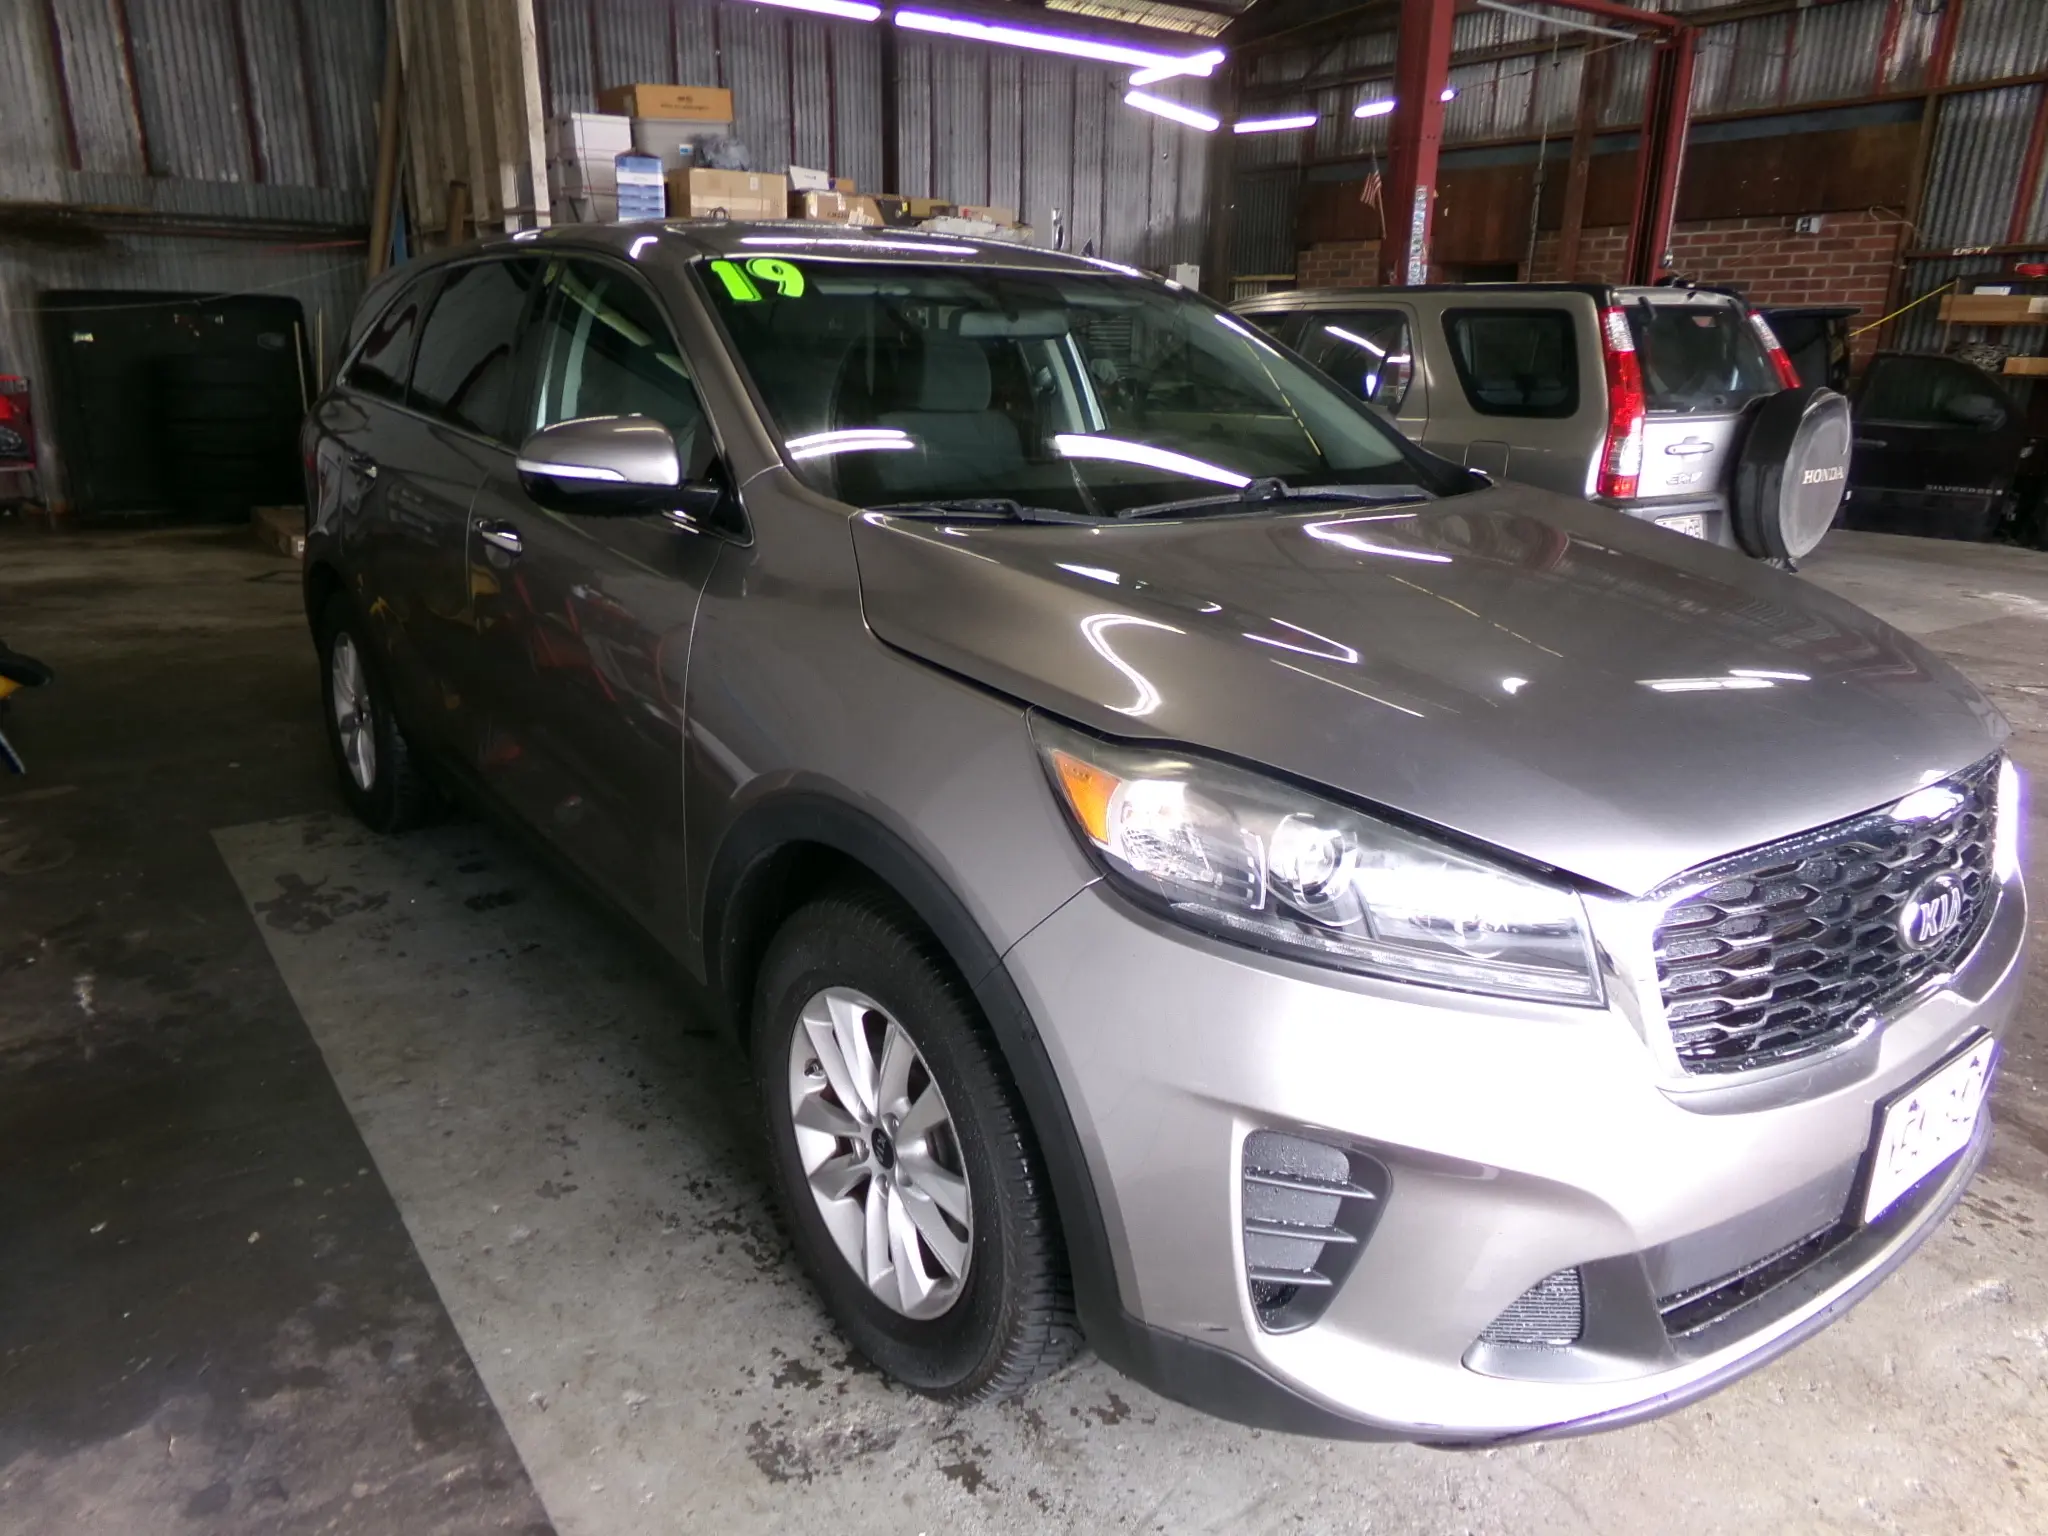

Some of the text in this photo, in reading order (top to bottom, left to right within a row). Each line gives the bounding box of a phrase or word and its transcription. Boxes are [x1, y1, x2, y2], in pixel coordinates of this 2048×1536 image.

[711, 259, 804, 302] 19
[1802, 466, 1844, 485] HONDA
[1919, 887, 1961, 941] KIA
